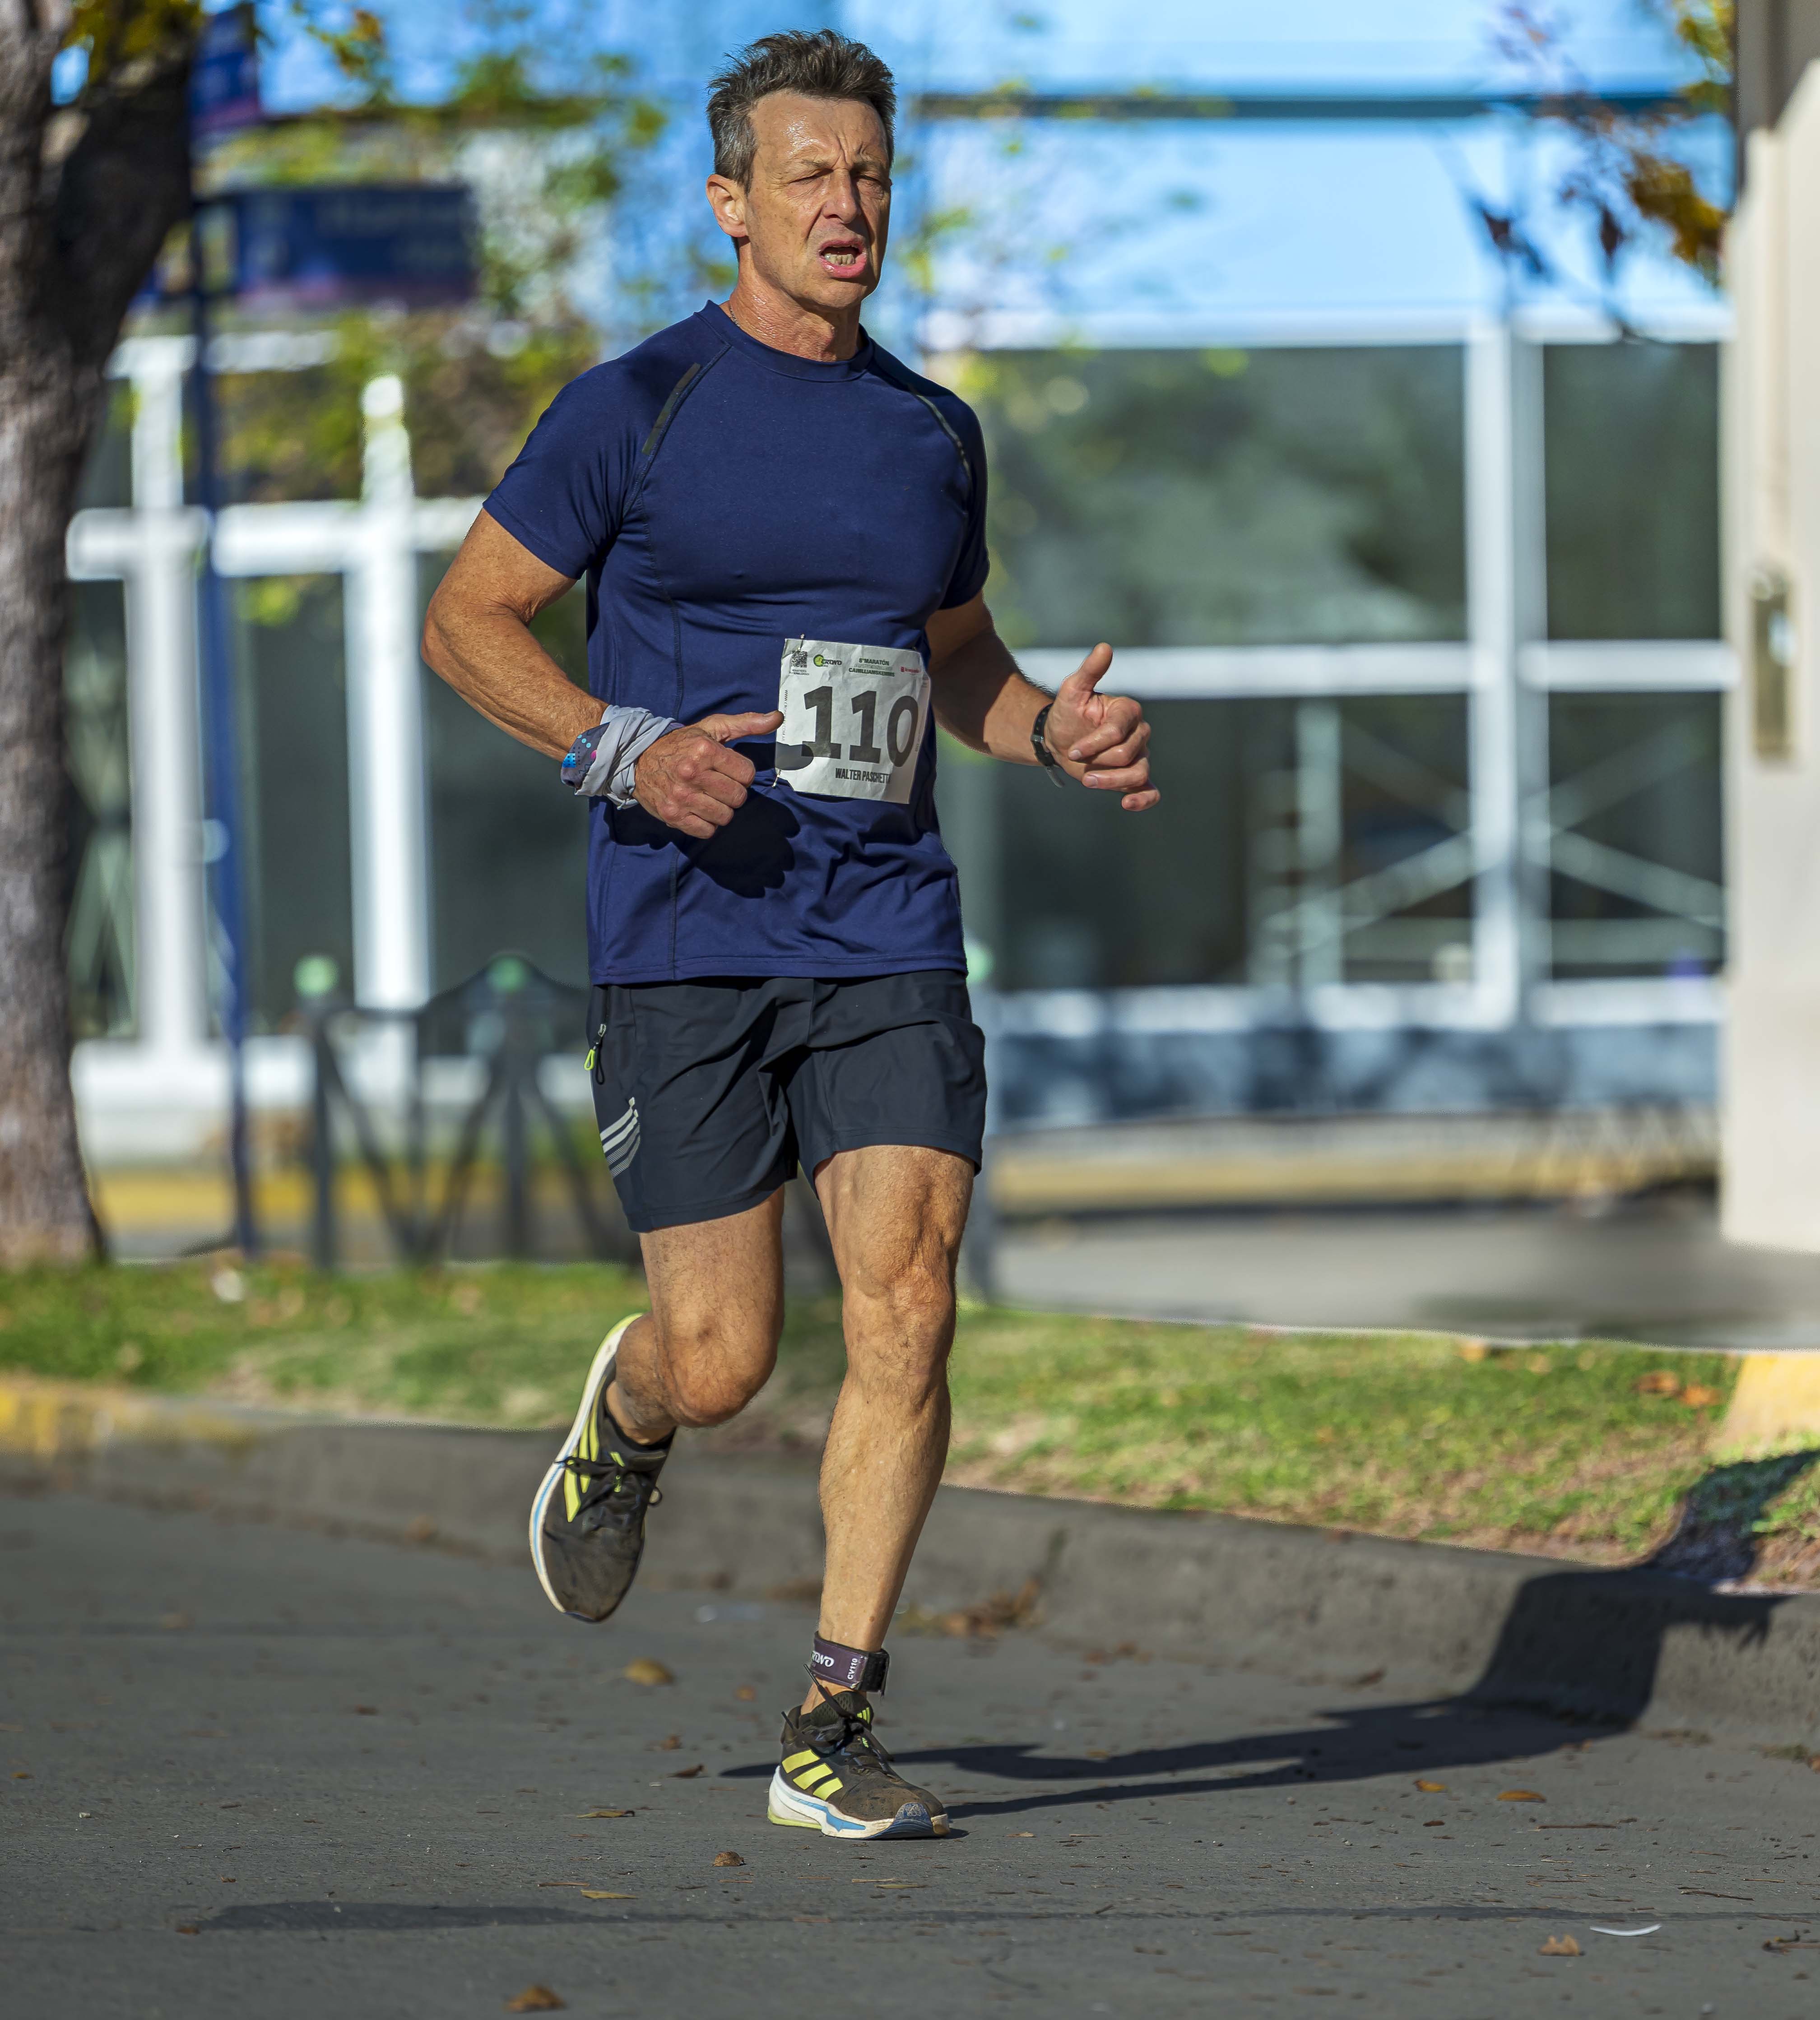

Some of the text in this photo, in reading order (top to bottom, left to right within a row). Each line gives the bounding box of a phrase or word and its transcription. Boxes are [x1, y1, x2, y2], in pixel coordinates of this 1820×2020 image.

[801, 686, 919, 768] 110
[835, 768, 861, 781] WALTER
[847, 1658, 858, 1680] CV110
